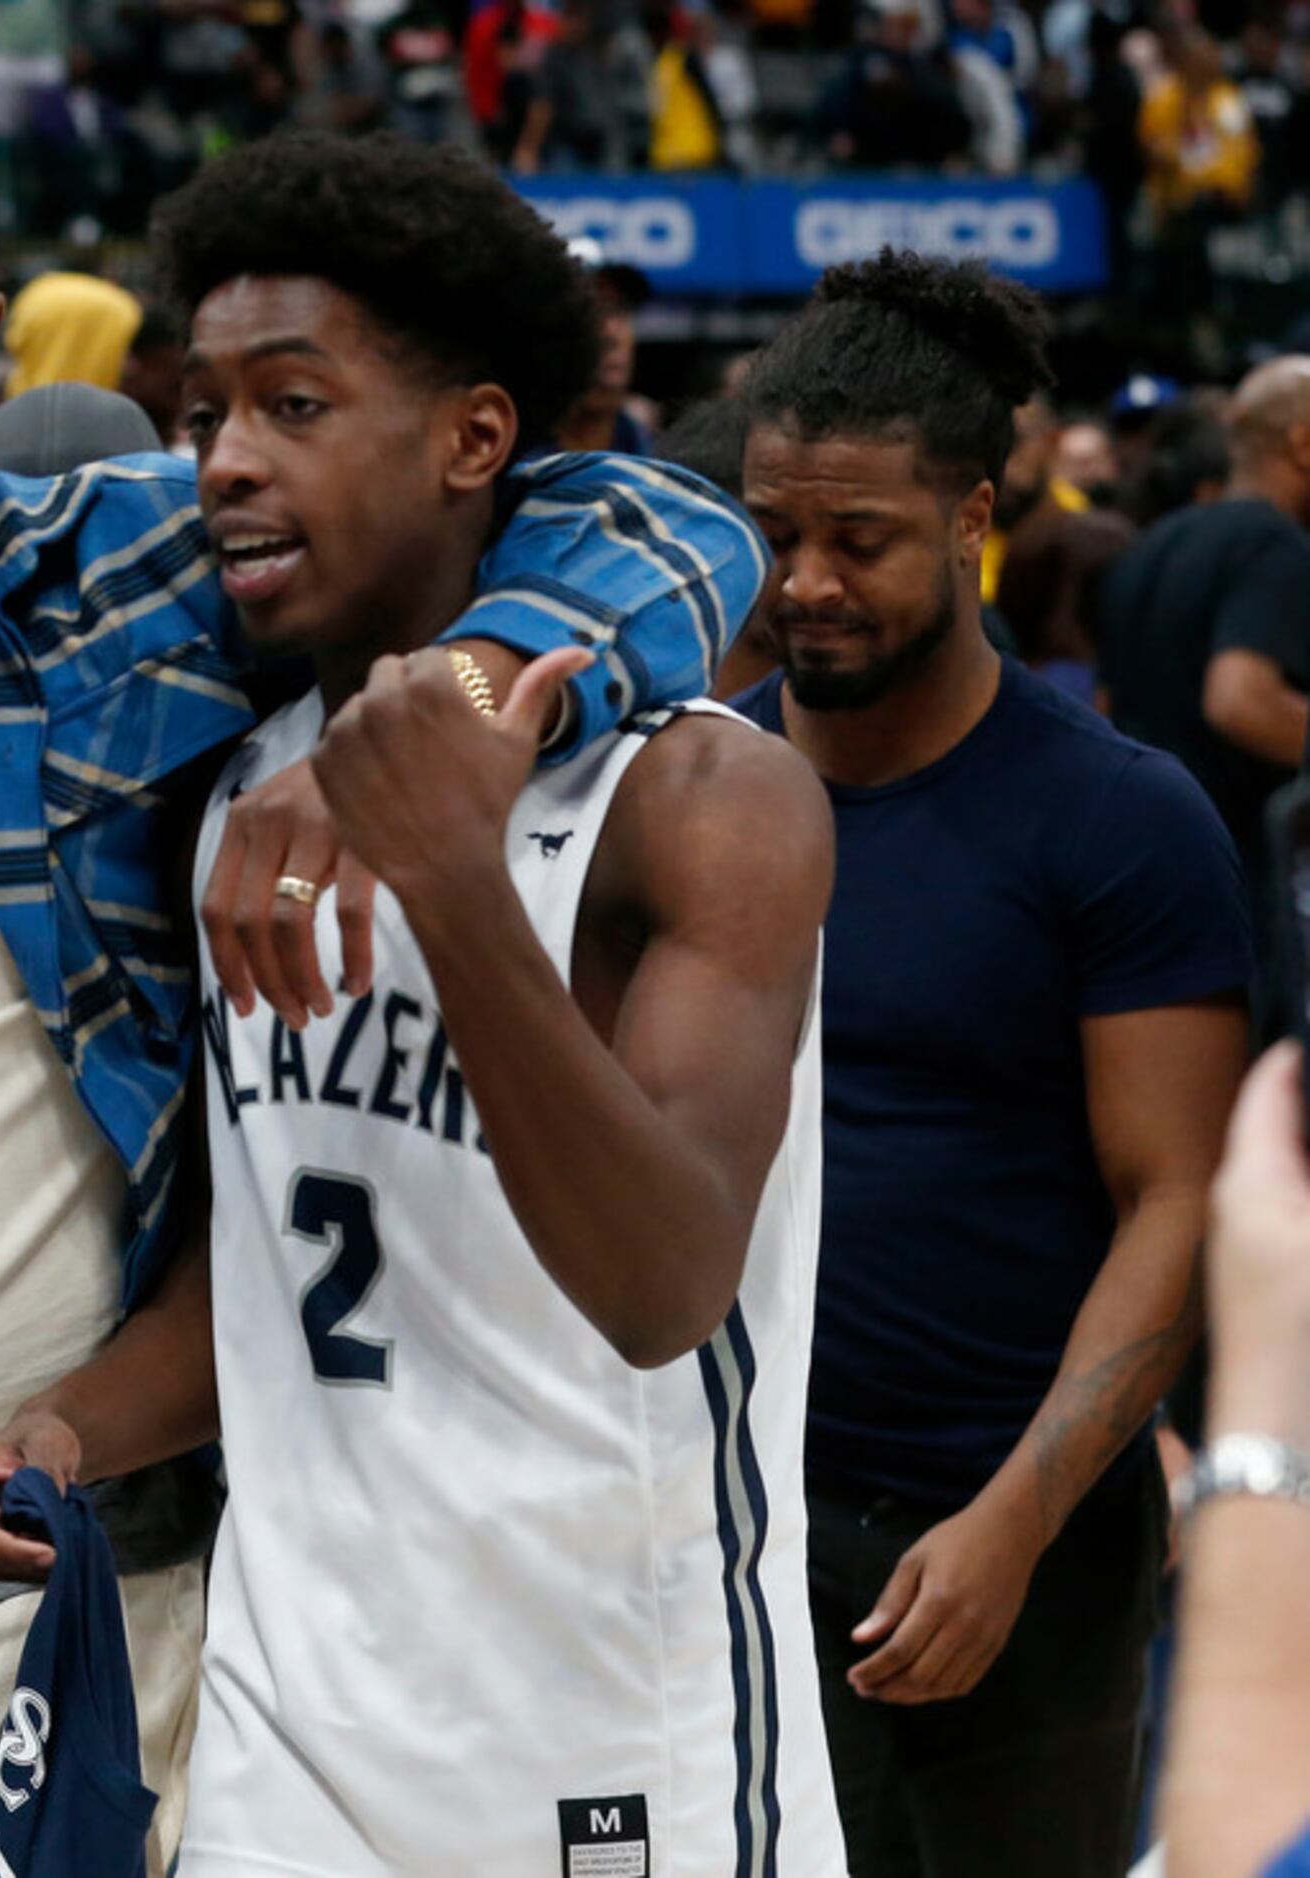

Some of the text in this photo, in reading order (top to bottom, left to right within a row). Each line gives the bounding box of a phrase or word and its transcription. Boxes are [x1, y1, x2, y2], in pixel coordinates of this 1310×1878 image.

[796, 197, 1059, 268] GEICO
[201, 977, 490, 1154] BLAZER
[282, 1164, 395, 1391] 2
[589, 1807, 622, 1834] M
